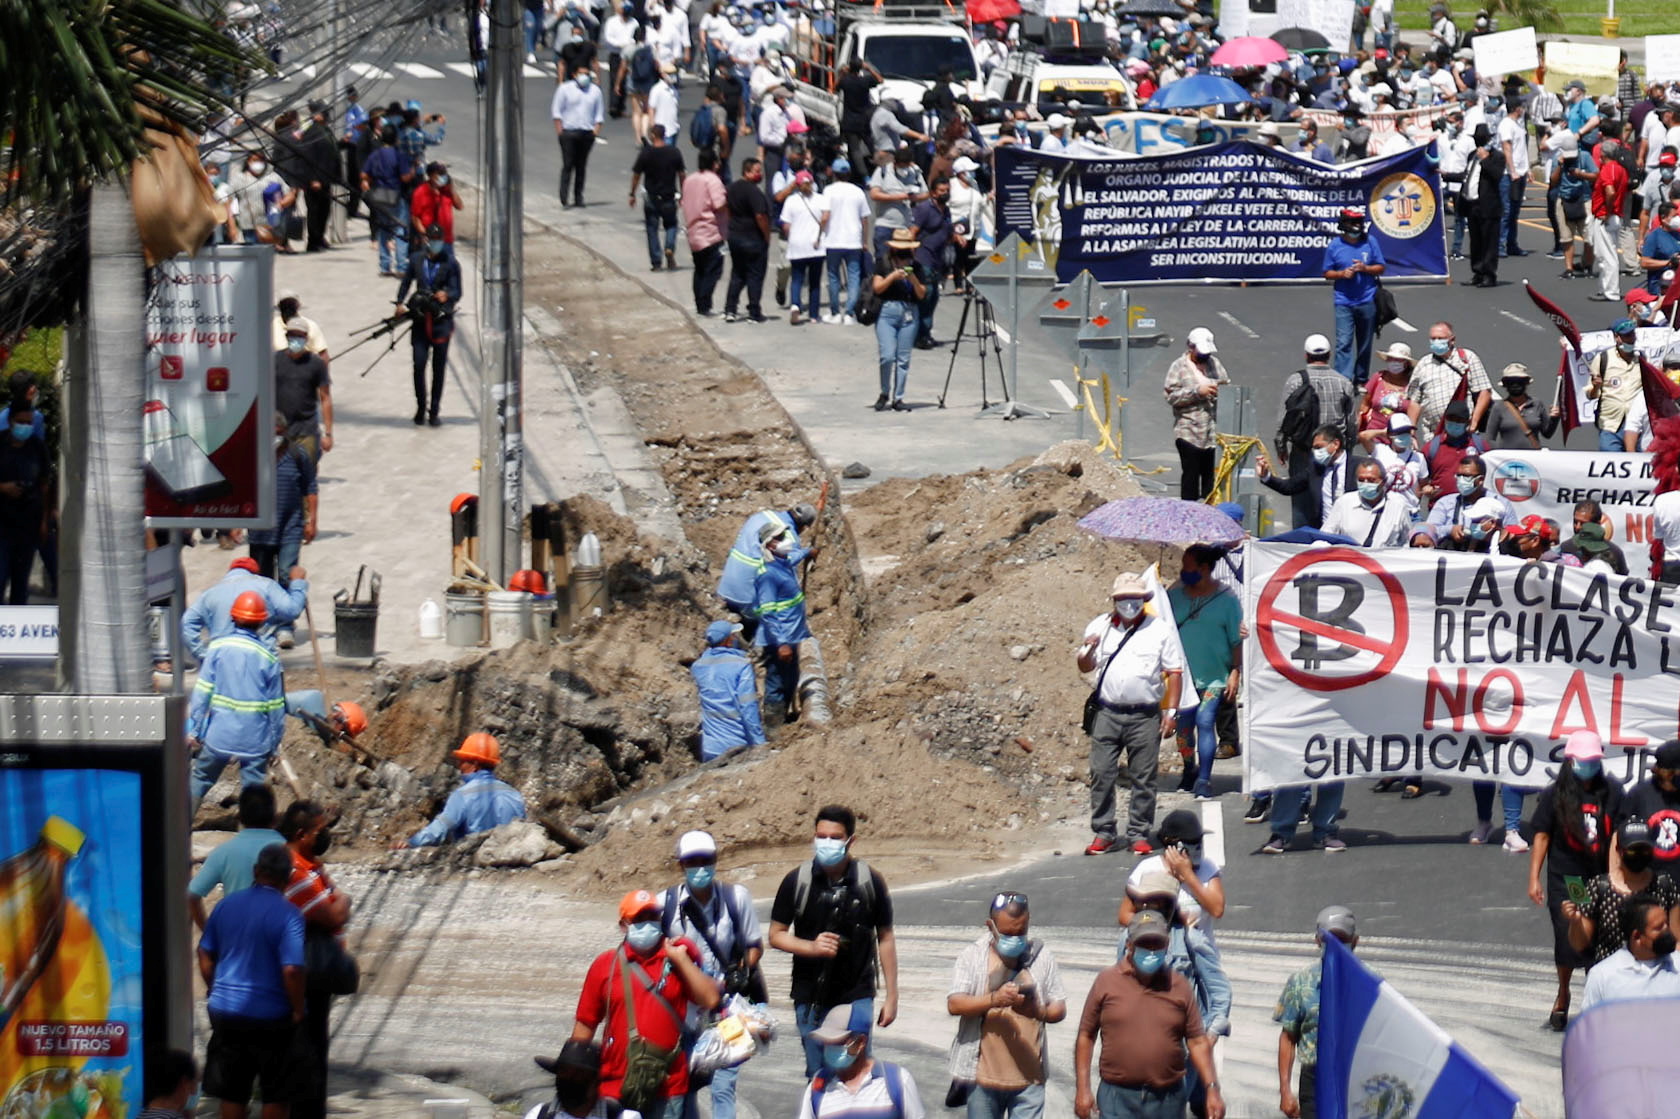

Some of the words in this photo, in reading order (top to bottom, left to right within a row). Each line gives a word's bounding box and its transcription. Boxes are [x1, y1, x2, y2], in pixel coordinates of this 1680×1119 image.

[1086, 163, 1112, 174] LOS
[1163, 155, 1255, 171] MAGISTRADOS
[1162, 171, 1221, 185] JUDICIAL
[1223, 171, 1242, 184] DE
[1242, 171, 1259, 184] LA
[1084, 191, 1100, 204] EL
[1100, 189, 1170, 204] SALVADOR,
[1172, 188, 1236, 202] EXIGIMOS
[1239, 187, 1255, 200] AL
[1256, 186, 1328, 202] PRESIDENTE
[1329, 191, 1346, 202] DE
[1348, 190, 1365, 201] LA
[1154, 205, 1194, 218] NAYIB
[1195, 203, 1243, 217] BUKELE
[1243, 203, 1274, 216] VETE
[1275, 204, 1291, 216] EL
[1291, 204, 1344, 218] DECRETO
[1081, 223, 1149, 237] REFORMAS
[1150, 222, 1161, 235] A
[1180, 221, 1203, 233] LEY
[1204, 220, 1223, 232] DE
[1248, 219, 1307, 233] CARRERA
[1305, 220, 1345, 234] JUDIC
[1082, 241, 1092, 253] A
[1093, 240, 1110, 253] LA
[1111, 237, 1179, 253] ASAMBLEA
[1180, 236, 1258, 250] LEGISLATIVA
[1259, 236, 1277, 249] LO
[1277, 235, 1332, 249] DEROGU
[1151, 253, 1175, 267] SER
[1176, 251, 1302, 266] INCONSTITUCIONAL.
[180, 300, 201, 309] sus
[196, 311, 235, 326] desde
[190, 327, 238, 349] lugar
[1587, 460, 1633, 479] LAS
[1434, 556, 1502, 608] LA
[1512, 560, 1675, 632] CLASE
[0, 623, 20, 638] 63
[1433, 607, 1638, 670] RECHAZA
[1422, 666, 1525, 735] NO
[1548, 667, 1648, 747] AL
[1303, 733, 1535, 779] SINDICATO
[21, 1024, 66, 1036] NUEVO
[68, 1022, 125, 1036] TAMAÑO
[34, 1038, 55, 1051] 1.5
[57, 1037, 111, 1052] LITROS
